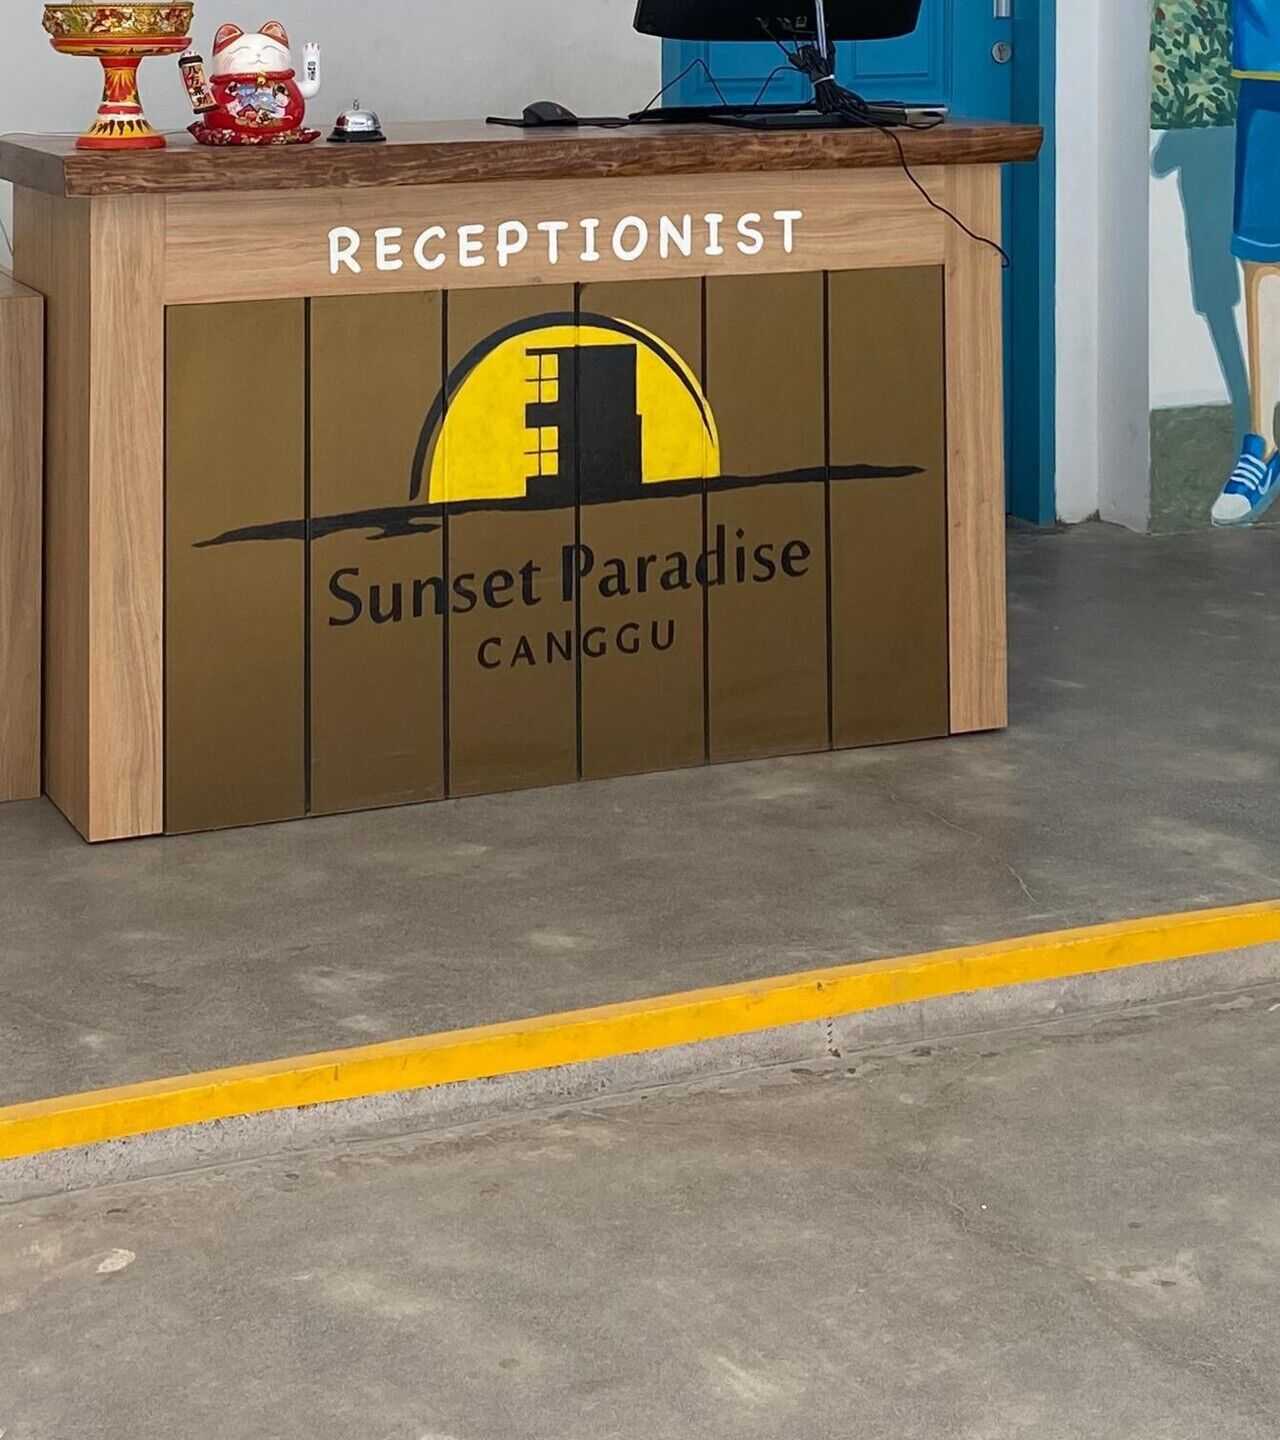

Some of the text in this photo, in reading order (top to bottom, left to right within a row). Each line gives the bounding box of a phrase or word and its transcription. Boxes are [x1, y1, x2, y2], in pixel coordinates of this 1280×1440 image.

[327, 209, 804, 275] RECEPTIONIST
[328, 524, 812, 626] Sunset Paradise
[477, 620, 676, 669] CANGGU
